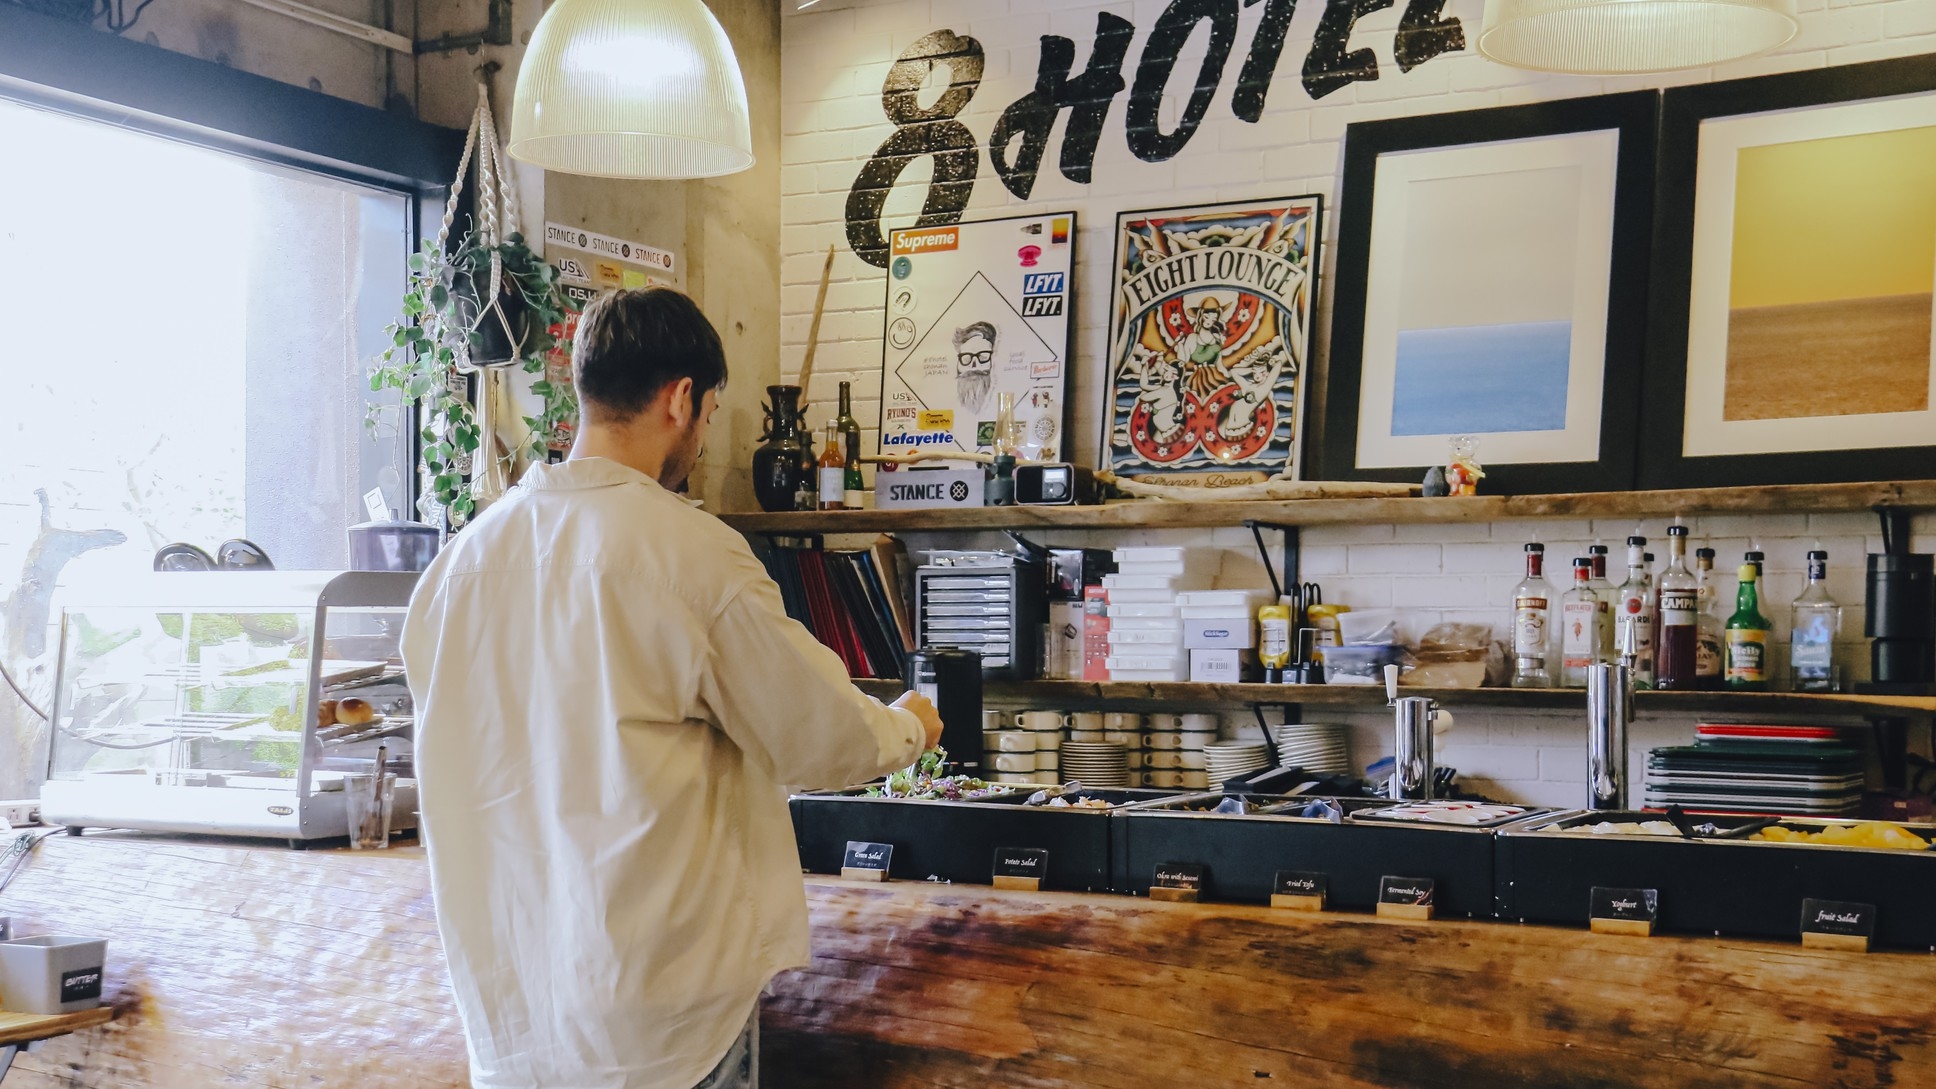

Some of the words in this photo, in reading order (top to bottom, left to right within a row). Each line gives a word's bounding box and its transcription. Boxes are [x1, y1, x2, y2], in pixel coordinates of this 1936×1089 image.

[845, 28, 985, 269] 8
[548, 227, 576, 244] STANCE
[896, 231, 956, 251] Supreme
[592, 238, 619, 254] STANCE
[635, 248, 661, 265] STANCE
[1129, 253, 1199, 306] EIGHT
[1205, 249, 1298, 299] LOUNGE
[883, 432, 954, 446] Lafayette
[890, 483, 945, 501] STANCE
[65, 973, 99, 987] BUTTER
